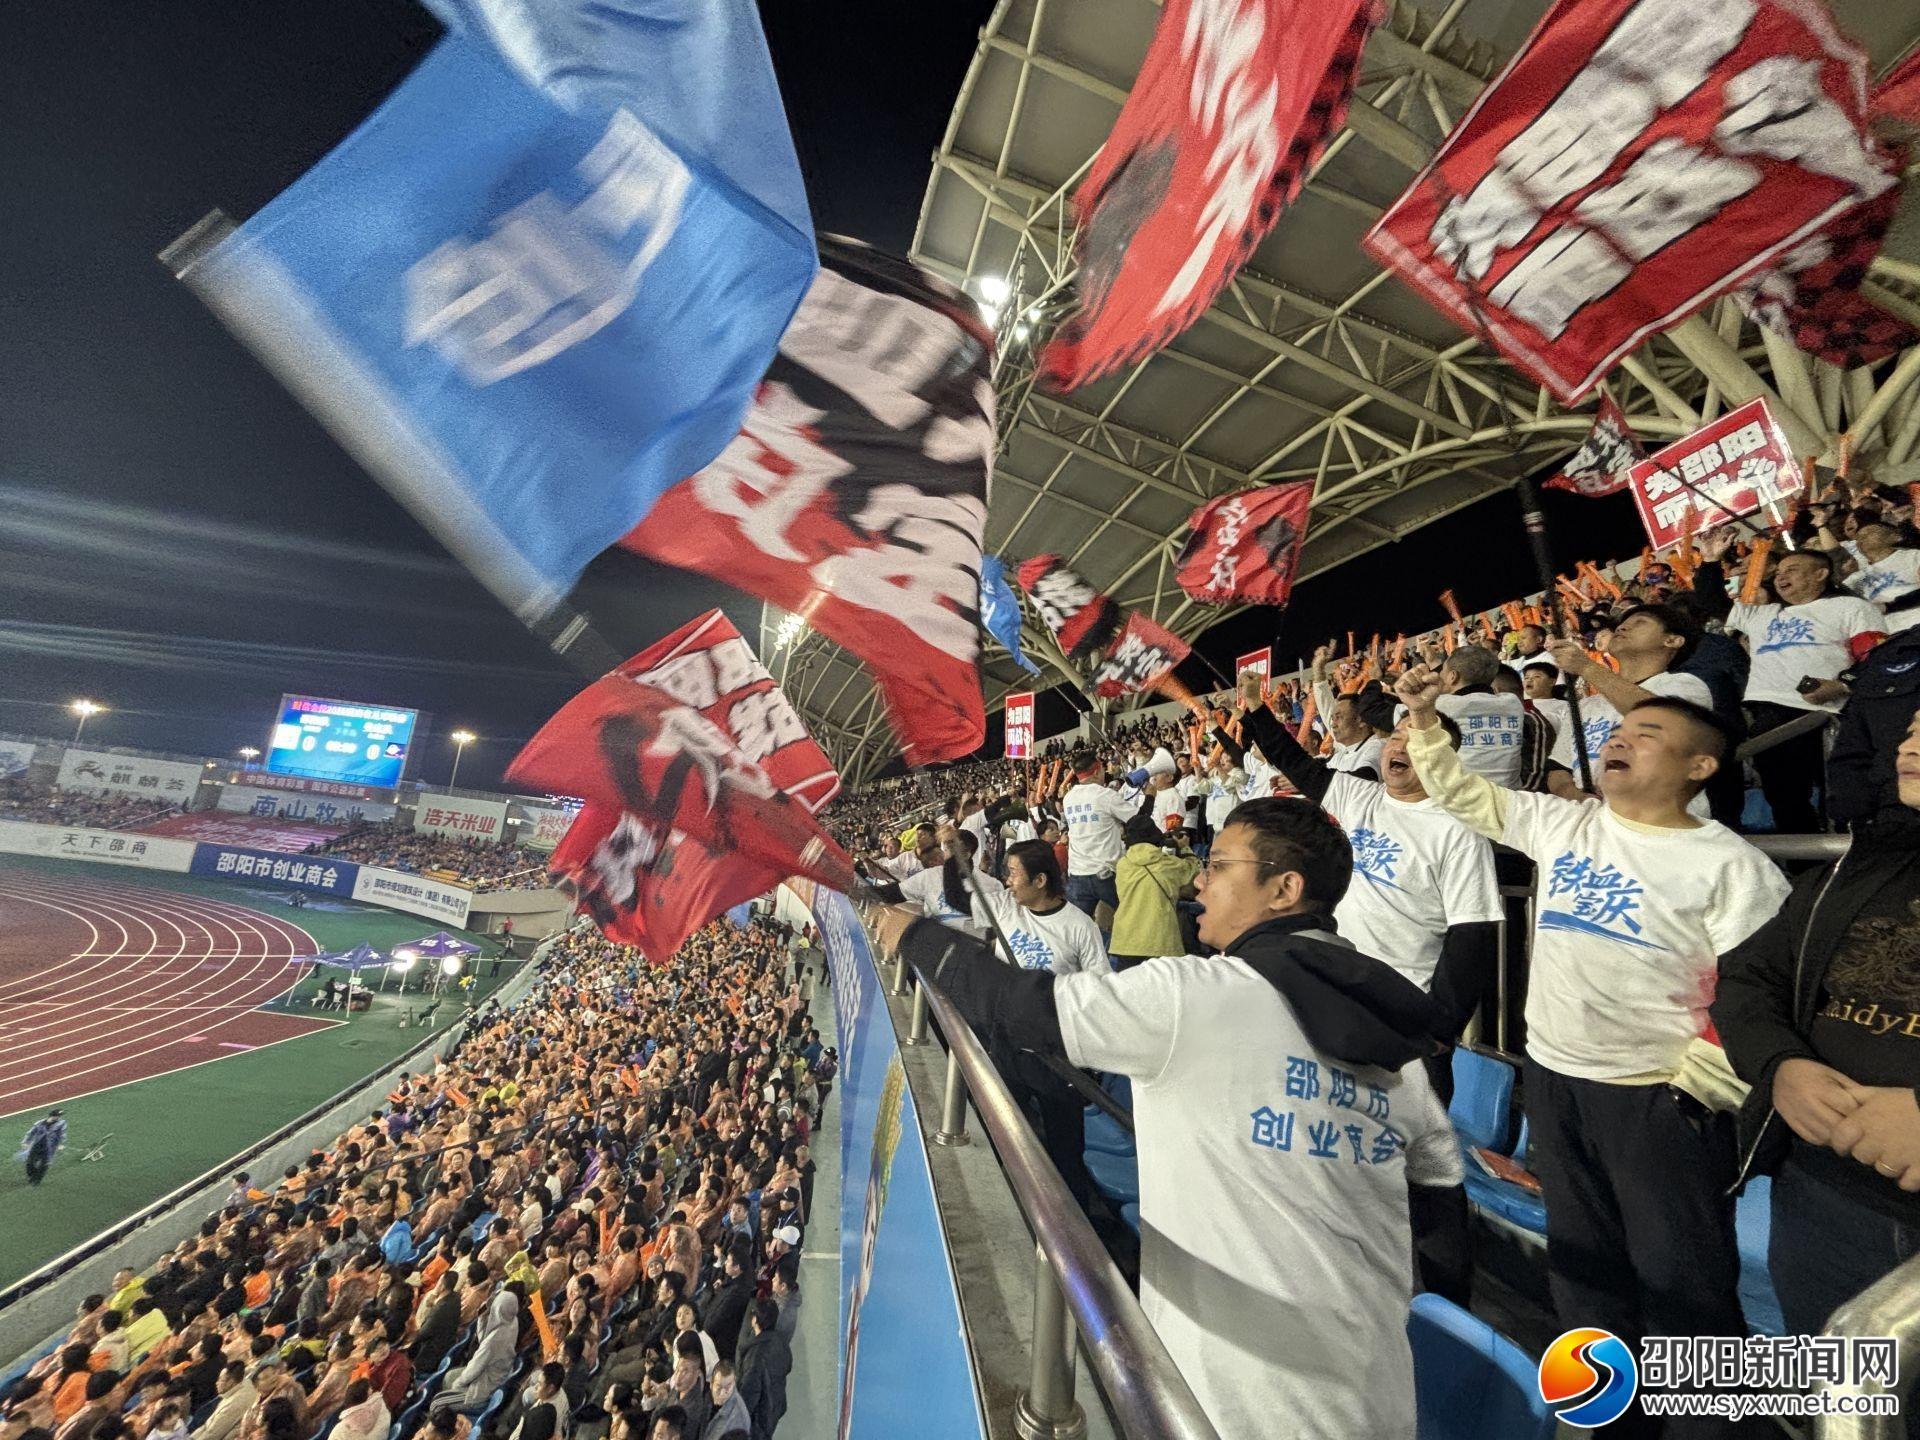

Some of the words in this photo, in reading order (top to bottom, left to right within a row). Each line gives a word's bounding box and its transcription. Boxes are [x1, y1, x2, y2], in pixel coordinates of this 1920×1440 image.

[422, 807, 497, 834] 浩天米业
[61, 833, 149, 855] 天下邵商
[216, 851, 339, 888] 邵阳市创业商会
[1548, 851, 1623, 900] 铁血
[1572, 877, 1644, 935] 宝庆
